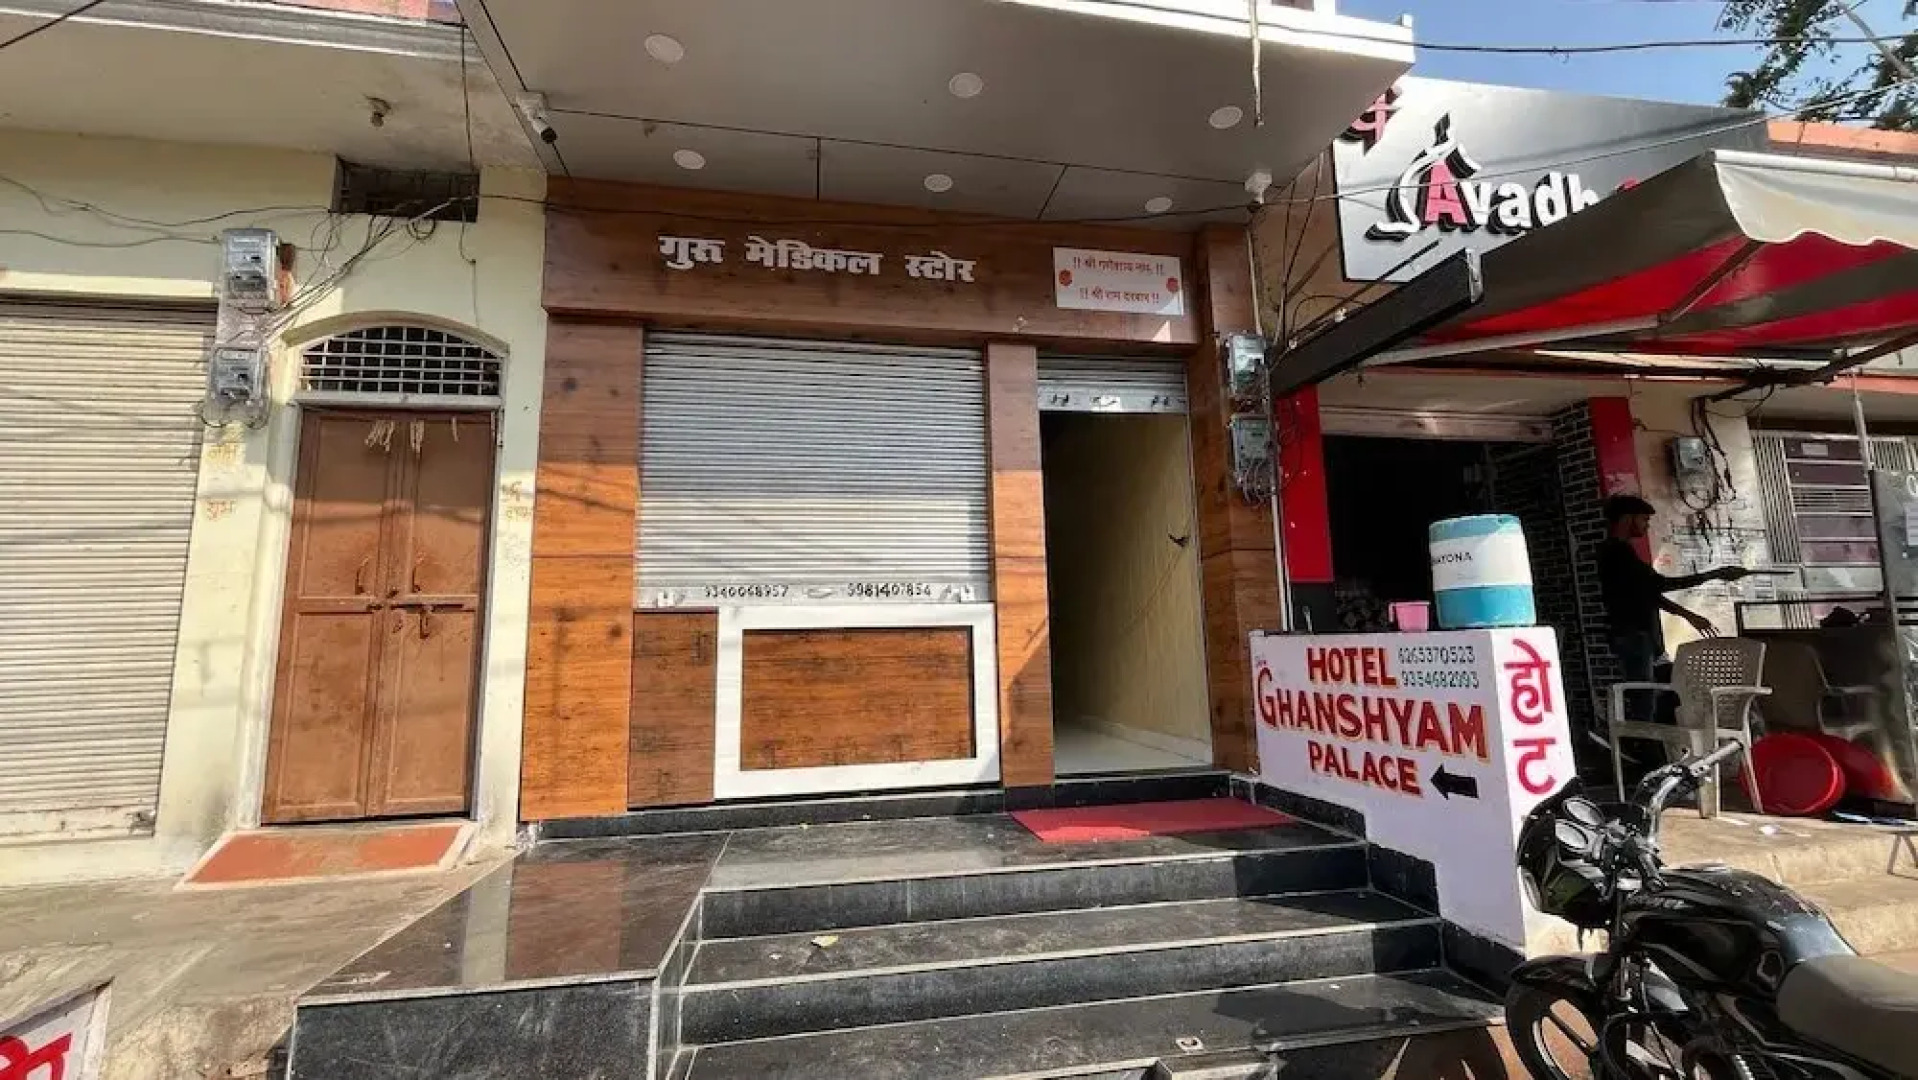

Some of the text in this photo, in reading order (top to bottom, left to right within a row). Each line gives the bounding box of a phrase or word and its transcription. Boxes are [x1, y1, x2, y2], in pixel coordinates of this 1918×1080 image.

[1424, 159, 1600, 229] Avadh
[658, 235, 976, 282] गुरु मेडिकल स्टोर
[1306, 647, 1397, 687] HOTEL
[1257, 667, 1488, 760] GHANSHYAM
[1307, 740, 1422, 796] PALACE
